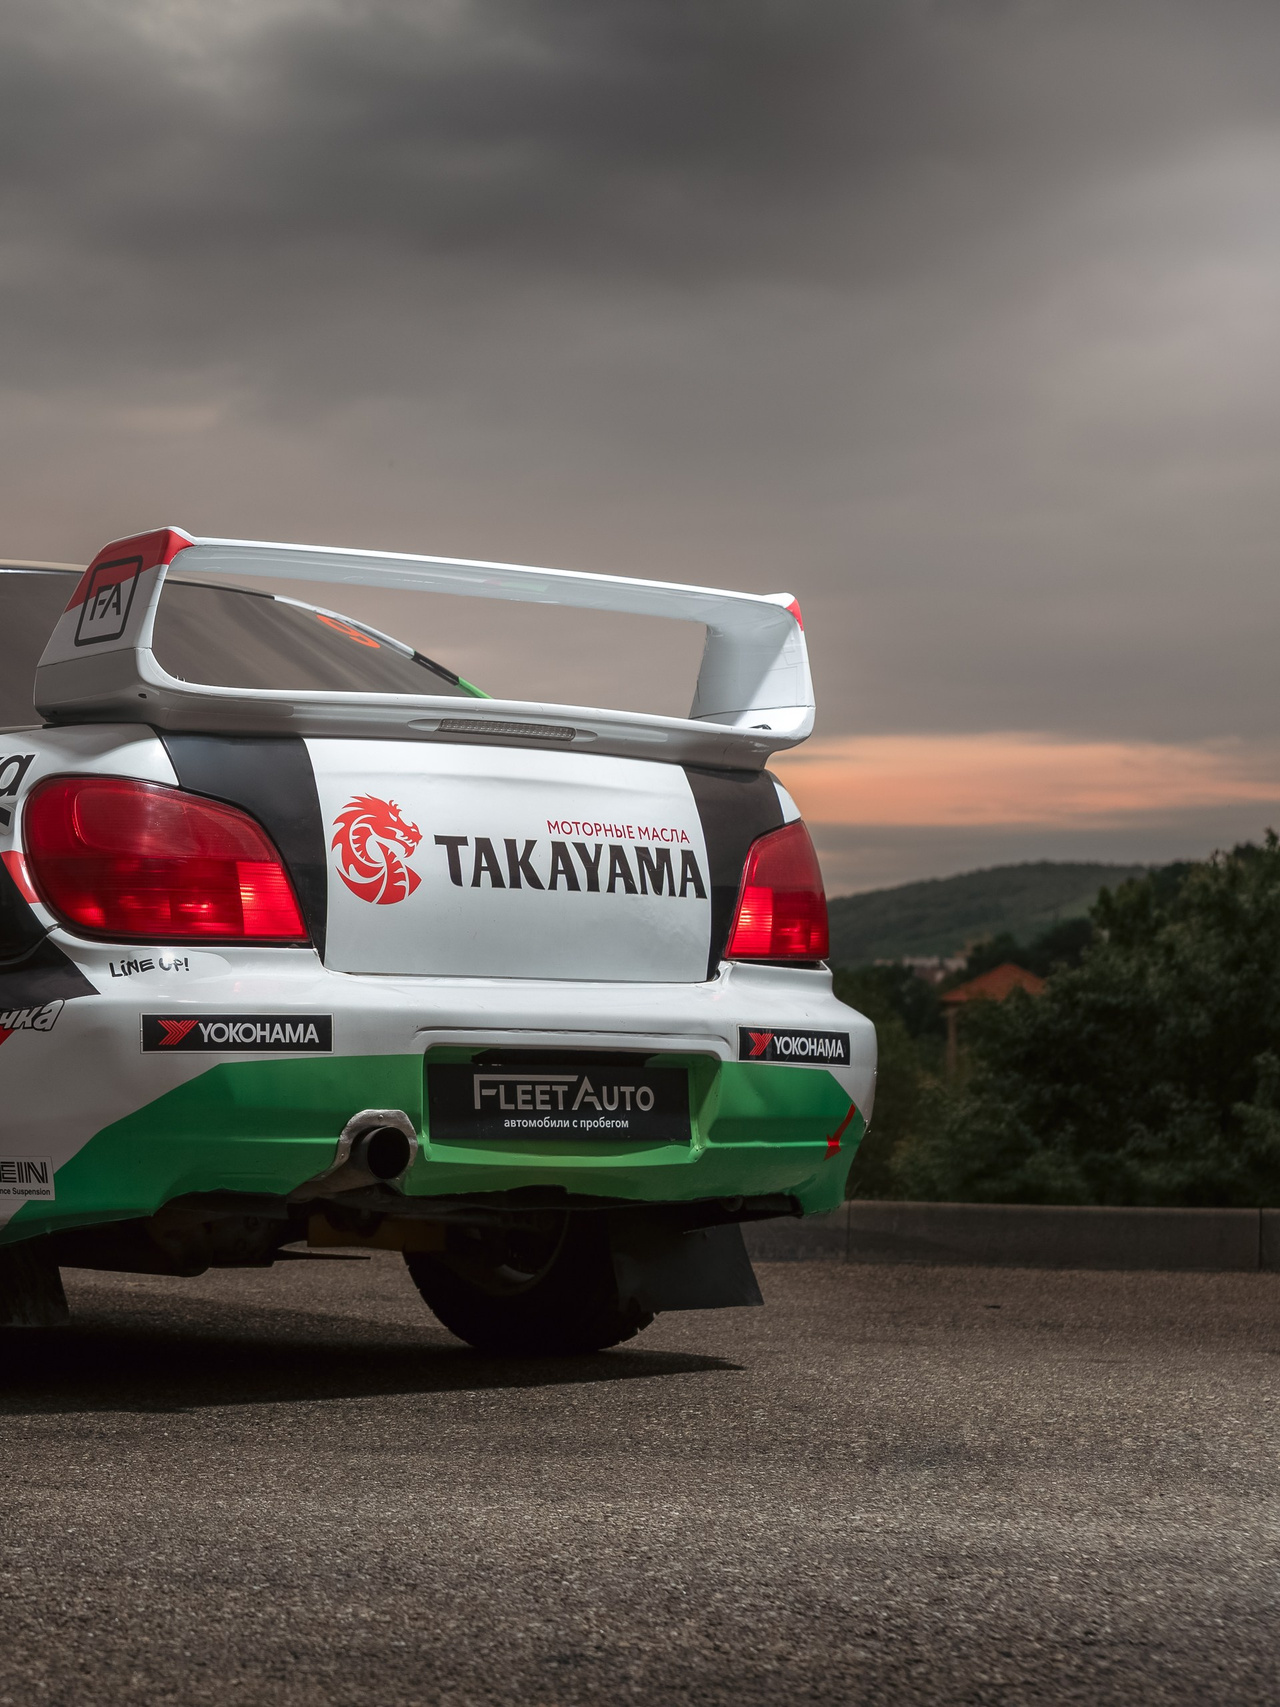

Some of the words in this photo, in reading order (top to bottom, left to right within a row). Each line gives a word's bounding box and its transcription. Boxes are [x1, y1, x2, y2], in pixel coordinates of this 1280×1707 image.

[89, 582, 122, 621] FA
[547, 820, 635, 840] МОТОРНЫЕ
[638, 826, 690, 843] МАСЛА
[434, 834, 708, 899] TAKAYAMA
[198, 1023, 320, 1044] YOKOHAMA
[774, 1035, 845, 1058] YOKOHAMA
[504, 1117, 570, 1129] автомобили
[572, 1119, 578, 1128] с
[580, 1117, 629, 1131] пробегом
[12, 1187, 51, 1197] Suspension
